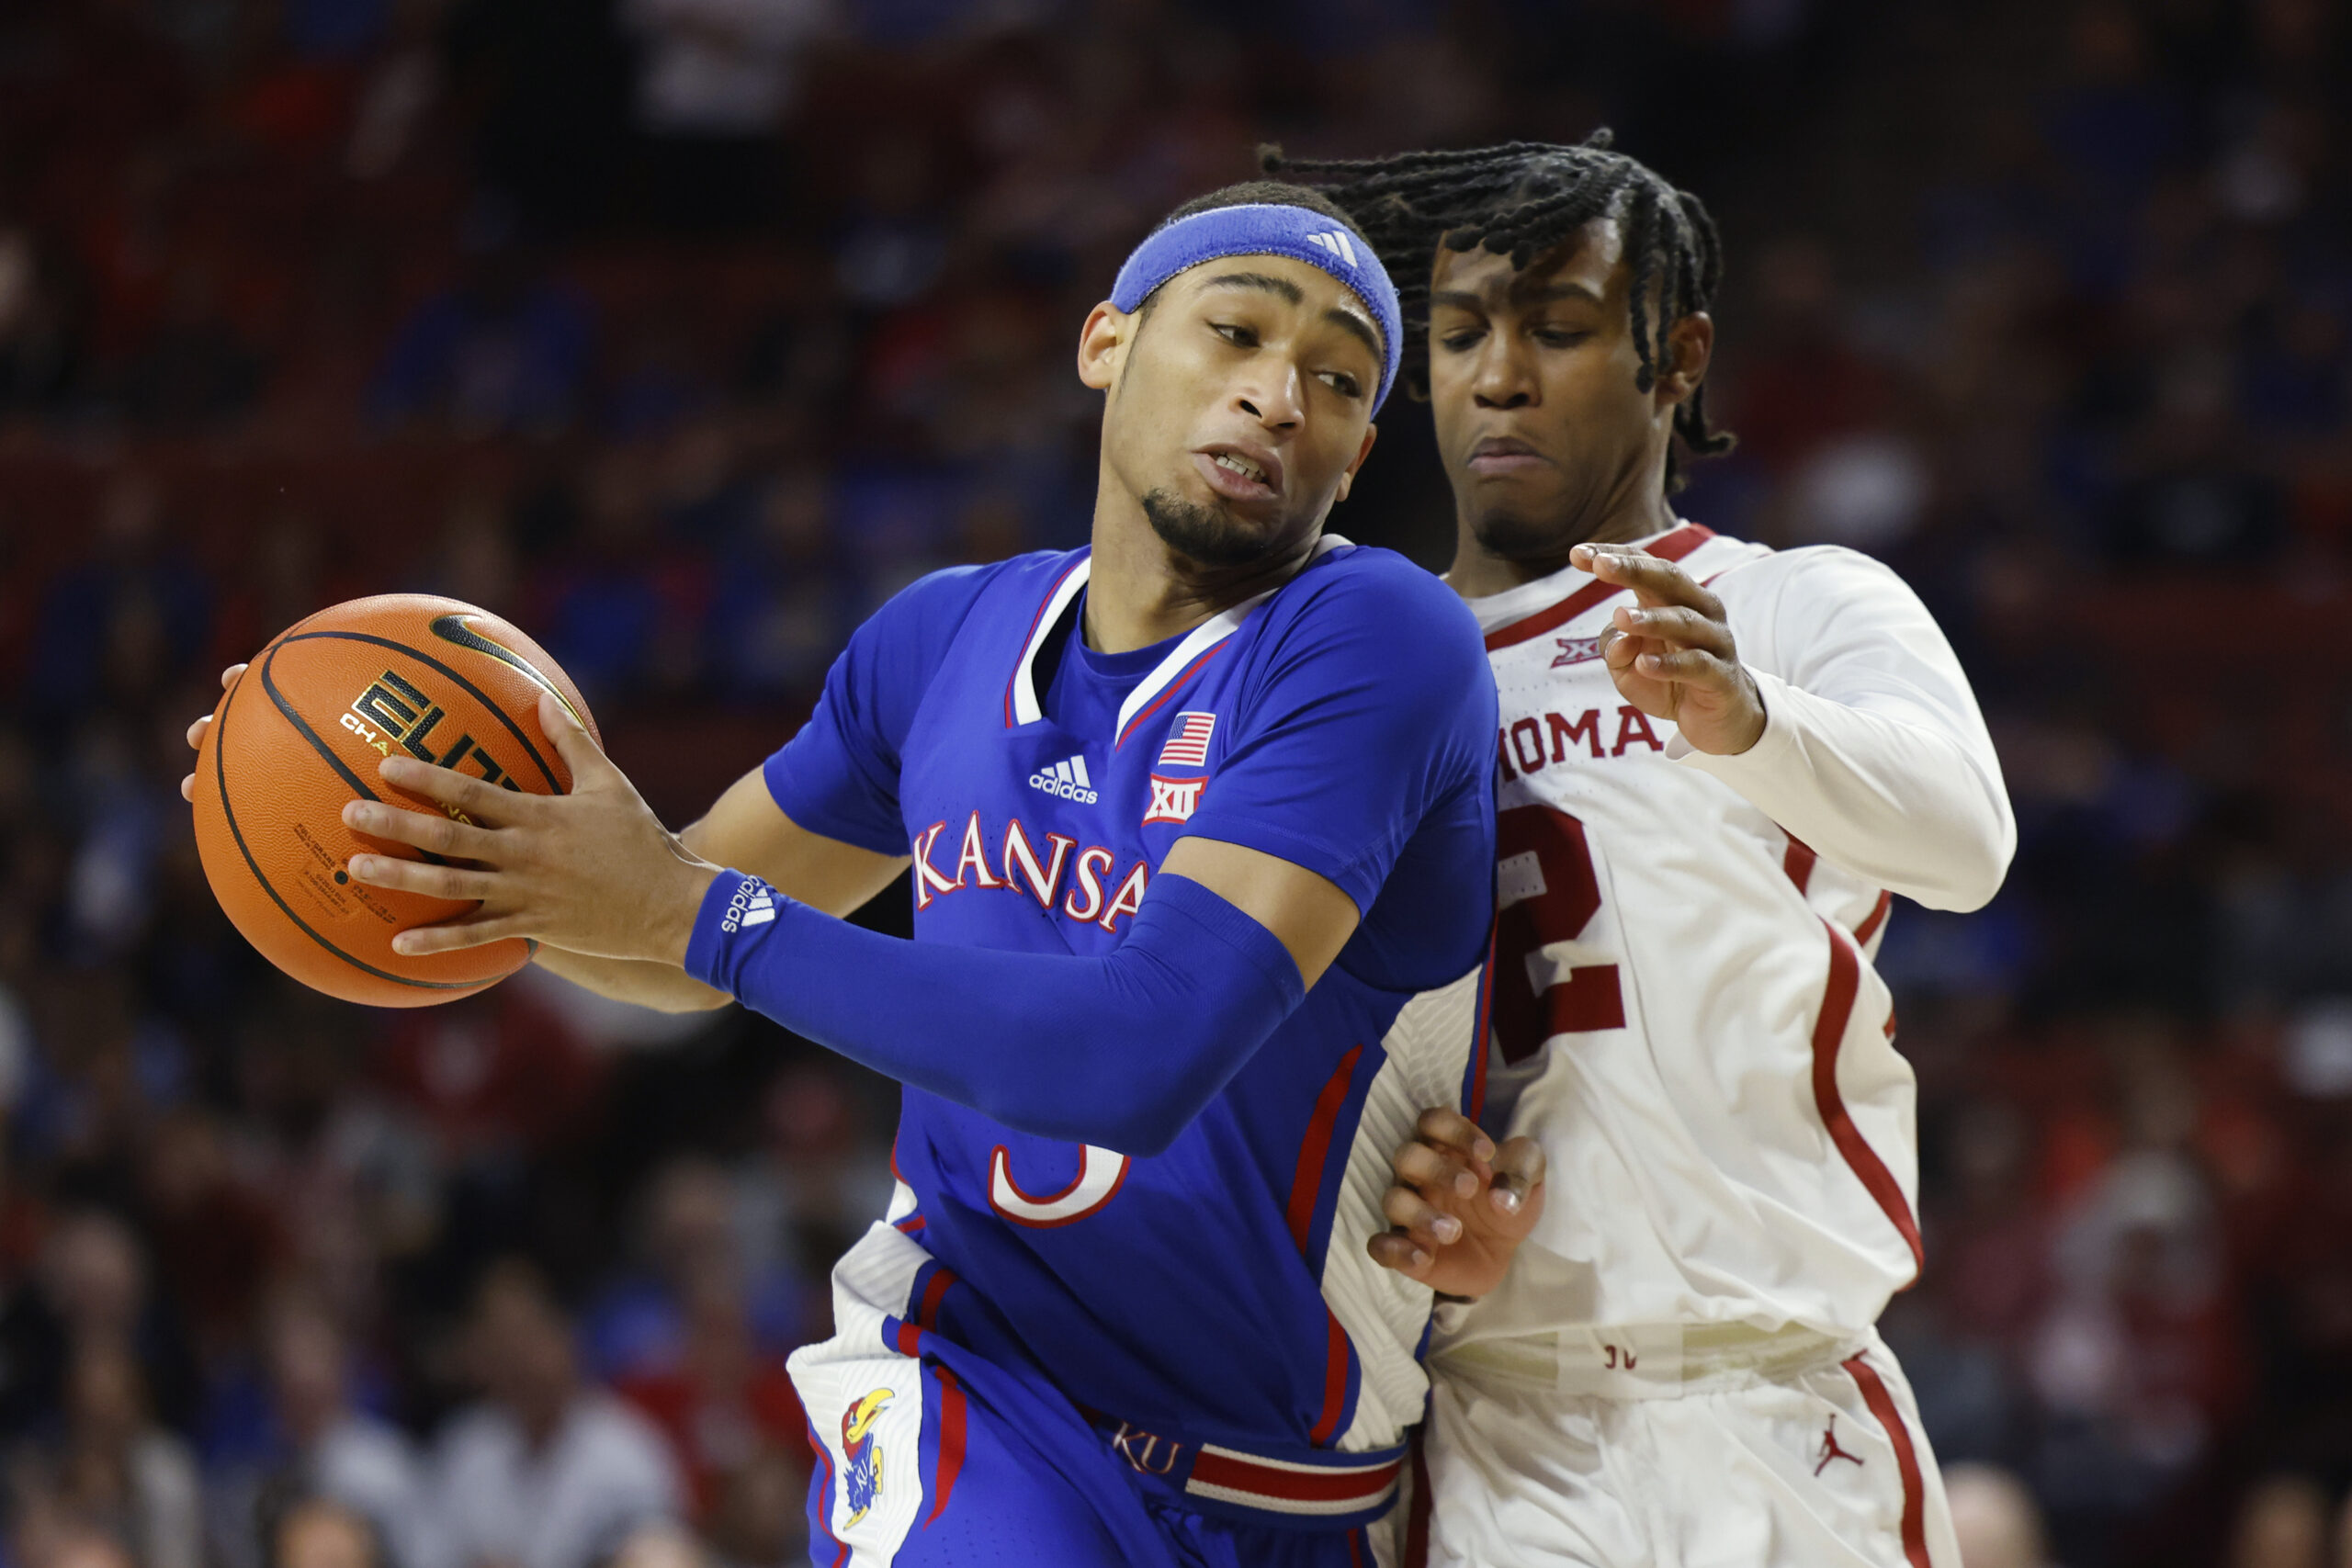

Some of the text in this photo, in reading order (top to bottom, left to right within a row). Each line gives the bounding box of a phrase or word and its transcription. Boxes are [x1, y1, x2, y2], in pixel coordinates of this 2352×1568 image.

[352, 670, 522, 793] ELIT
[1029, 773, 1098, 805] adidas
[1143, 777, 1205, 824] XII
[913, 809, 1149, 933] KANSA
[721, 874, 761, 933] adidas
[1113, 1421, 1183, 1475] KU
